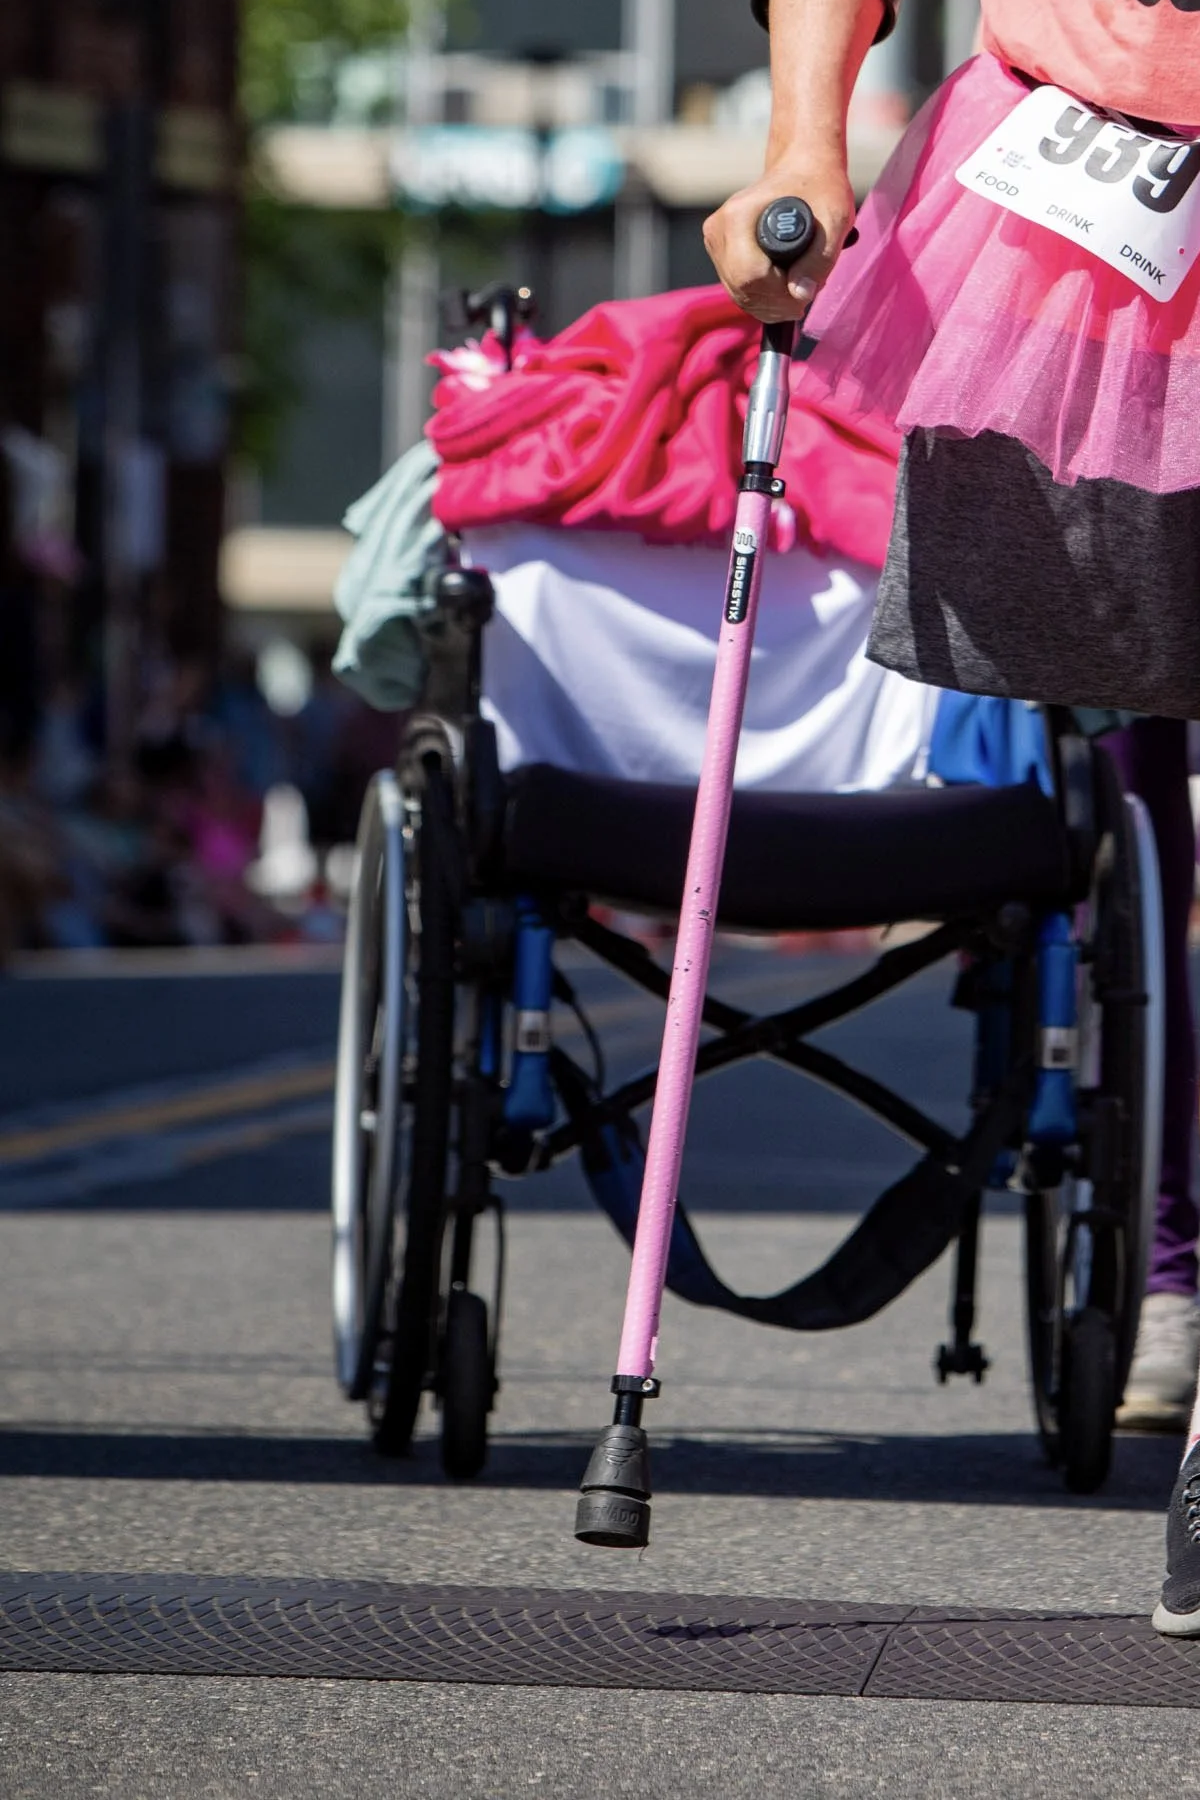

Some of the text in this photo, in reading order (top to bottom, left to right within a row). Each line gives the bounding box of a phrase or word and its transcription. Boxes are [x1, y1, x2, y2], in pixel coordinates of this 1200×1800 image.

[975, 171, 1167, 286] FOOD DRINK DRINK
[727, 556, 748, 620] SIDESTIX
